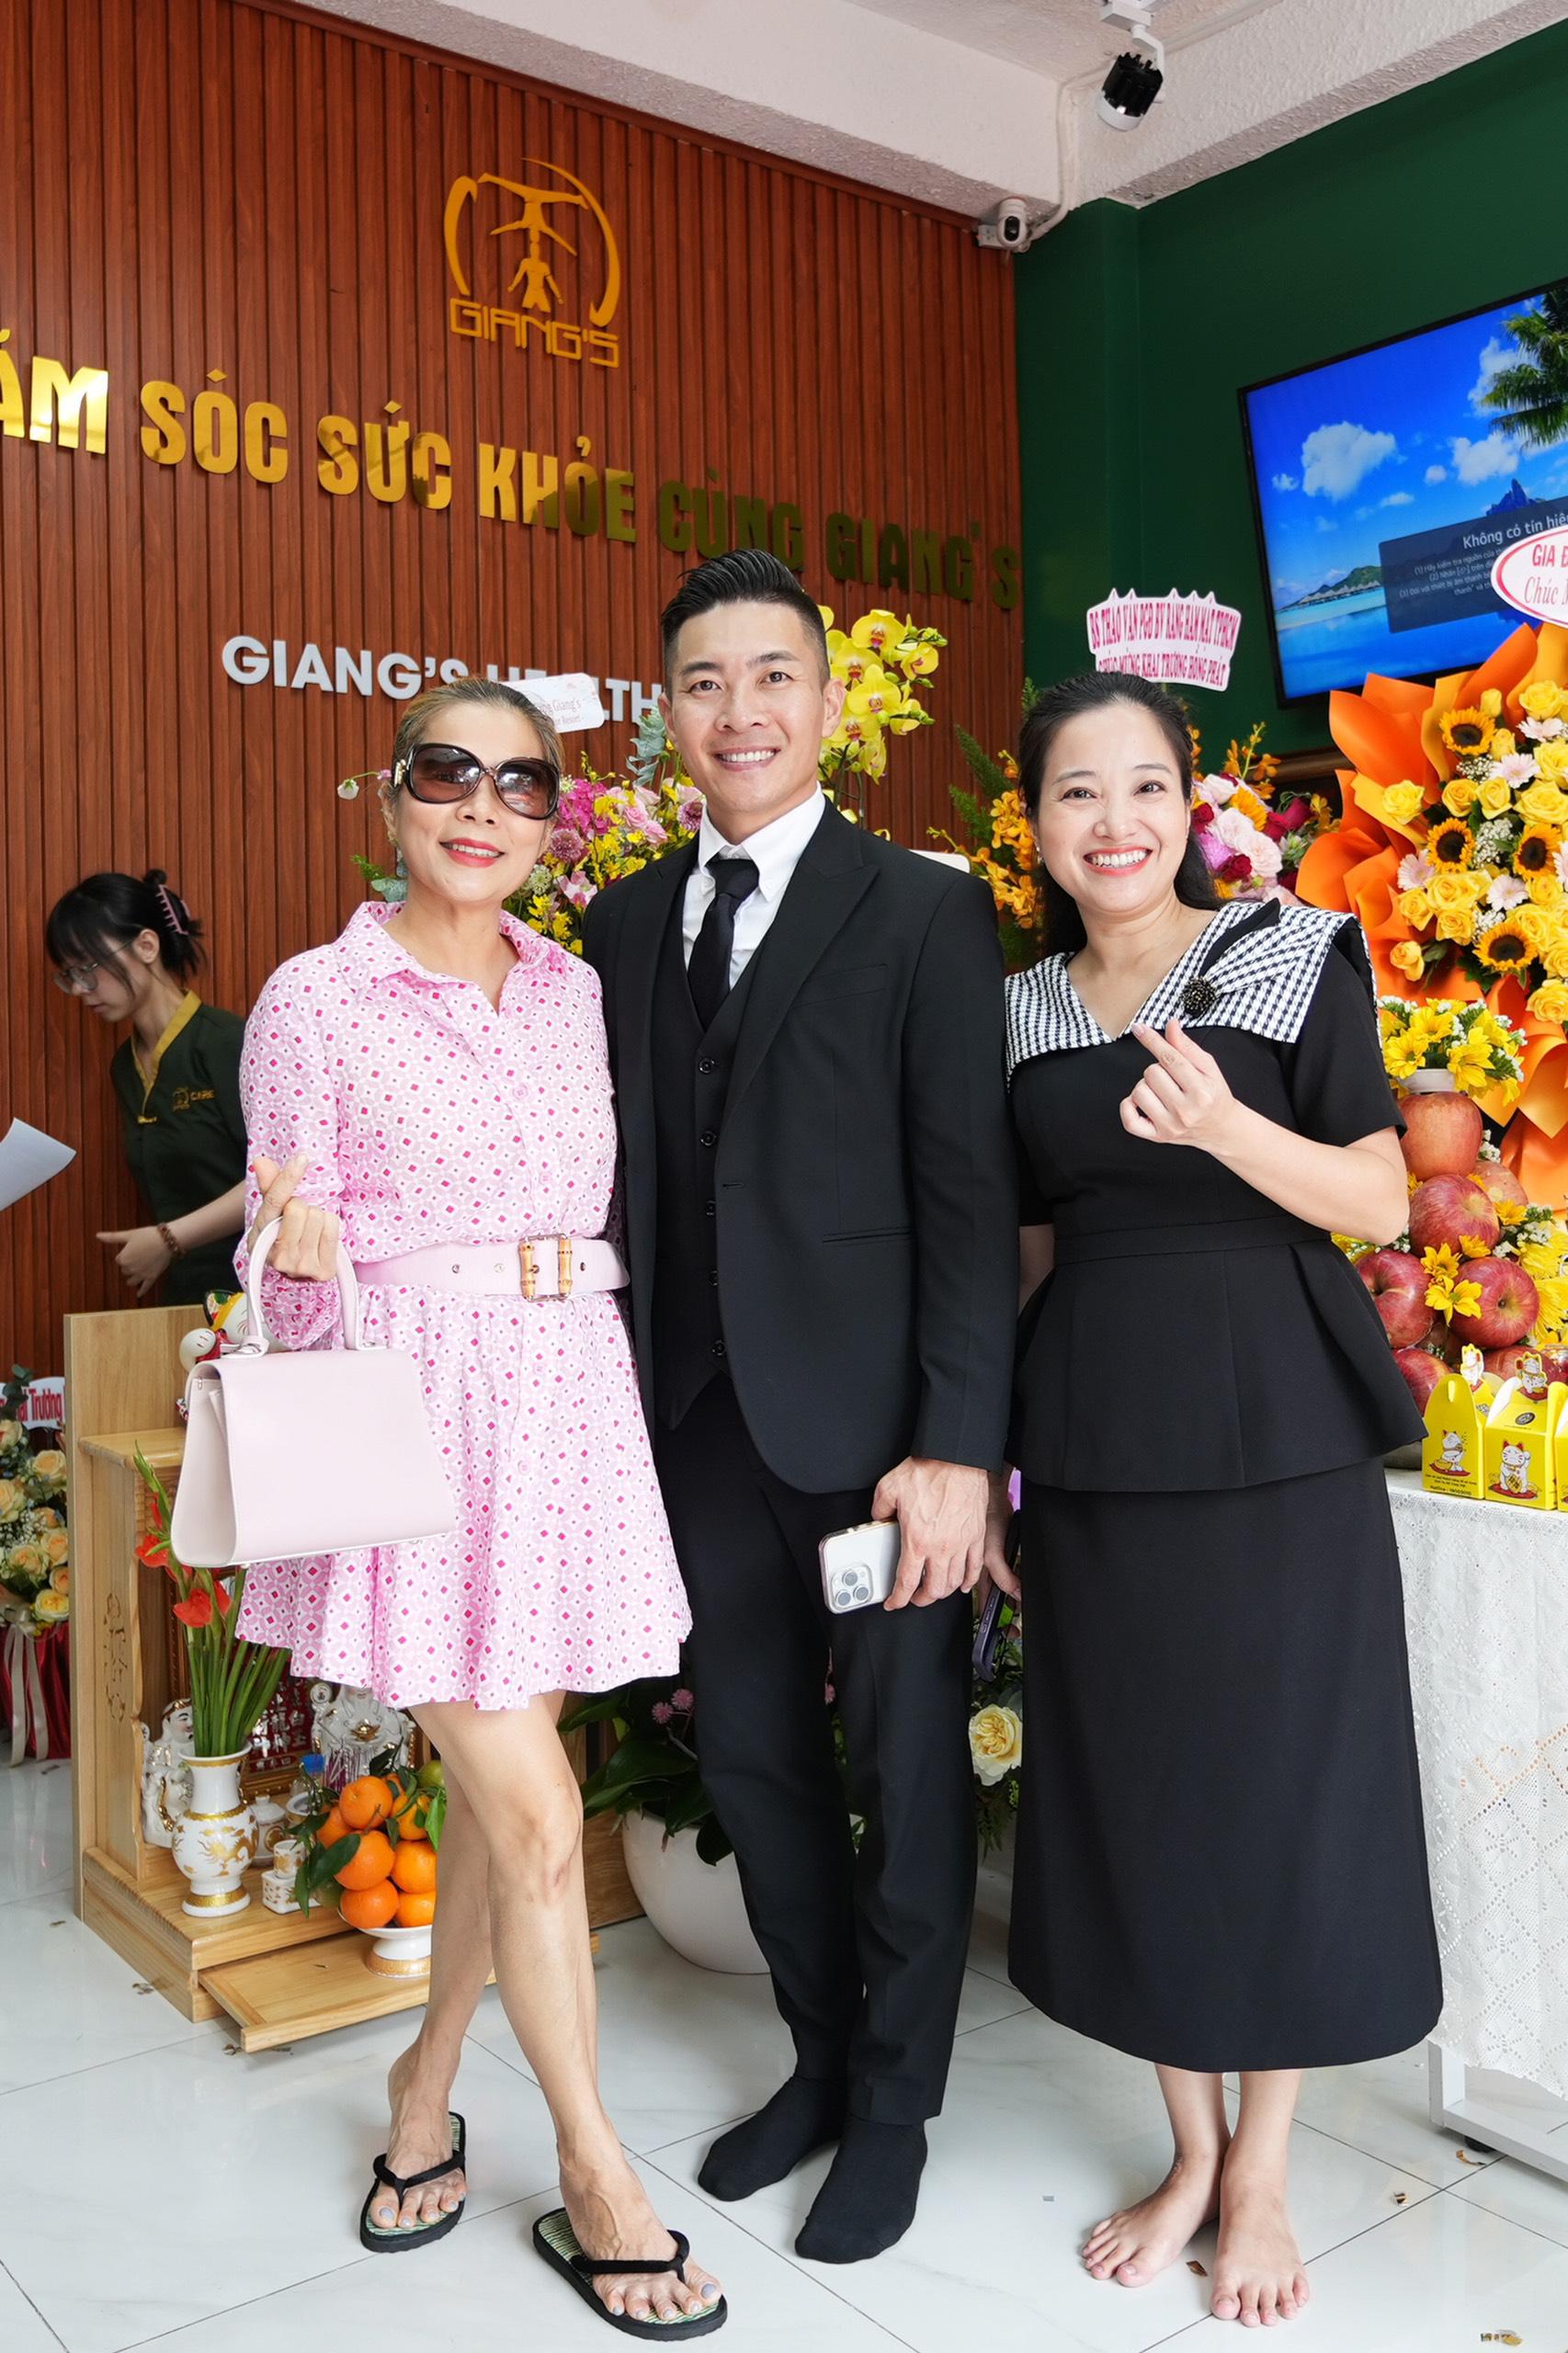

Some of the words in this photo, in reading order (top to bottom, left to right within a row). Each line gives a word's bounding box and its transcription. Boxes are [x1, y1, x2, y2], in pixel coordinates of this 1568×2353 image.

[450, 298, 619, 369] GIANG'S
[141, 369, 289, 483] SÓC
[317, 400, 452, 510] SỨC
[479, 436, 636, 543] KHỎE
[660, 467, 803, 573] CÙNG
[1463, 531, 1503, 549] Không
[1506, 524, 1521, 539] có
[1532, 544, 1555, 566] GIA
[1524, 575, 1559, 604] Chúc
